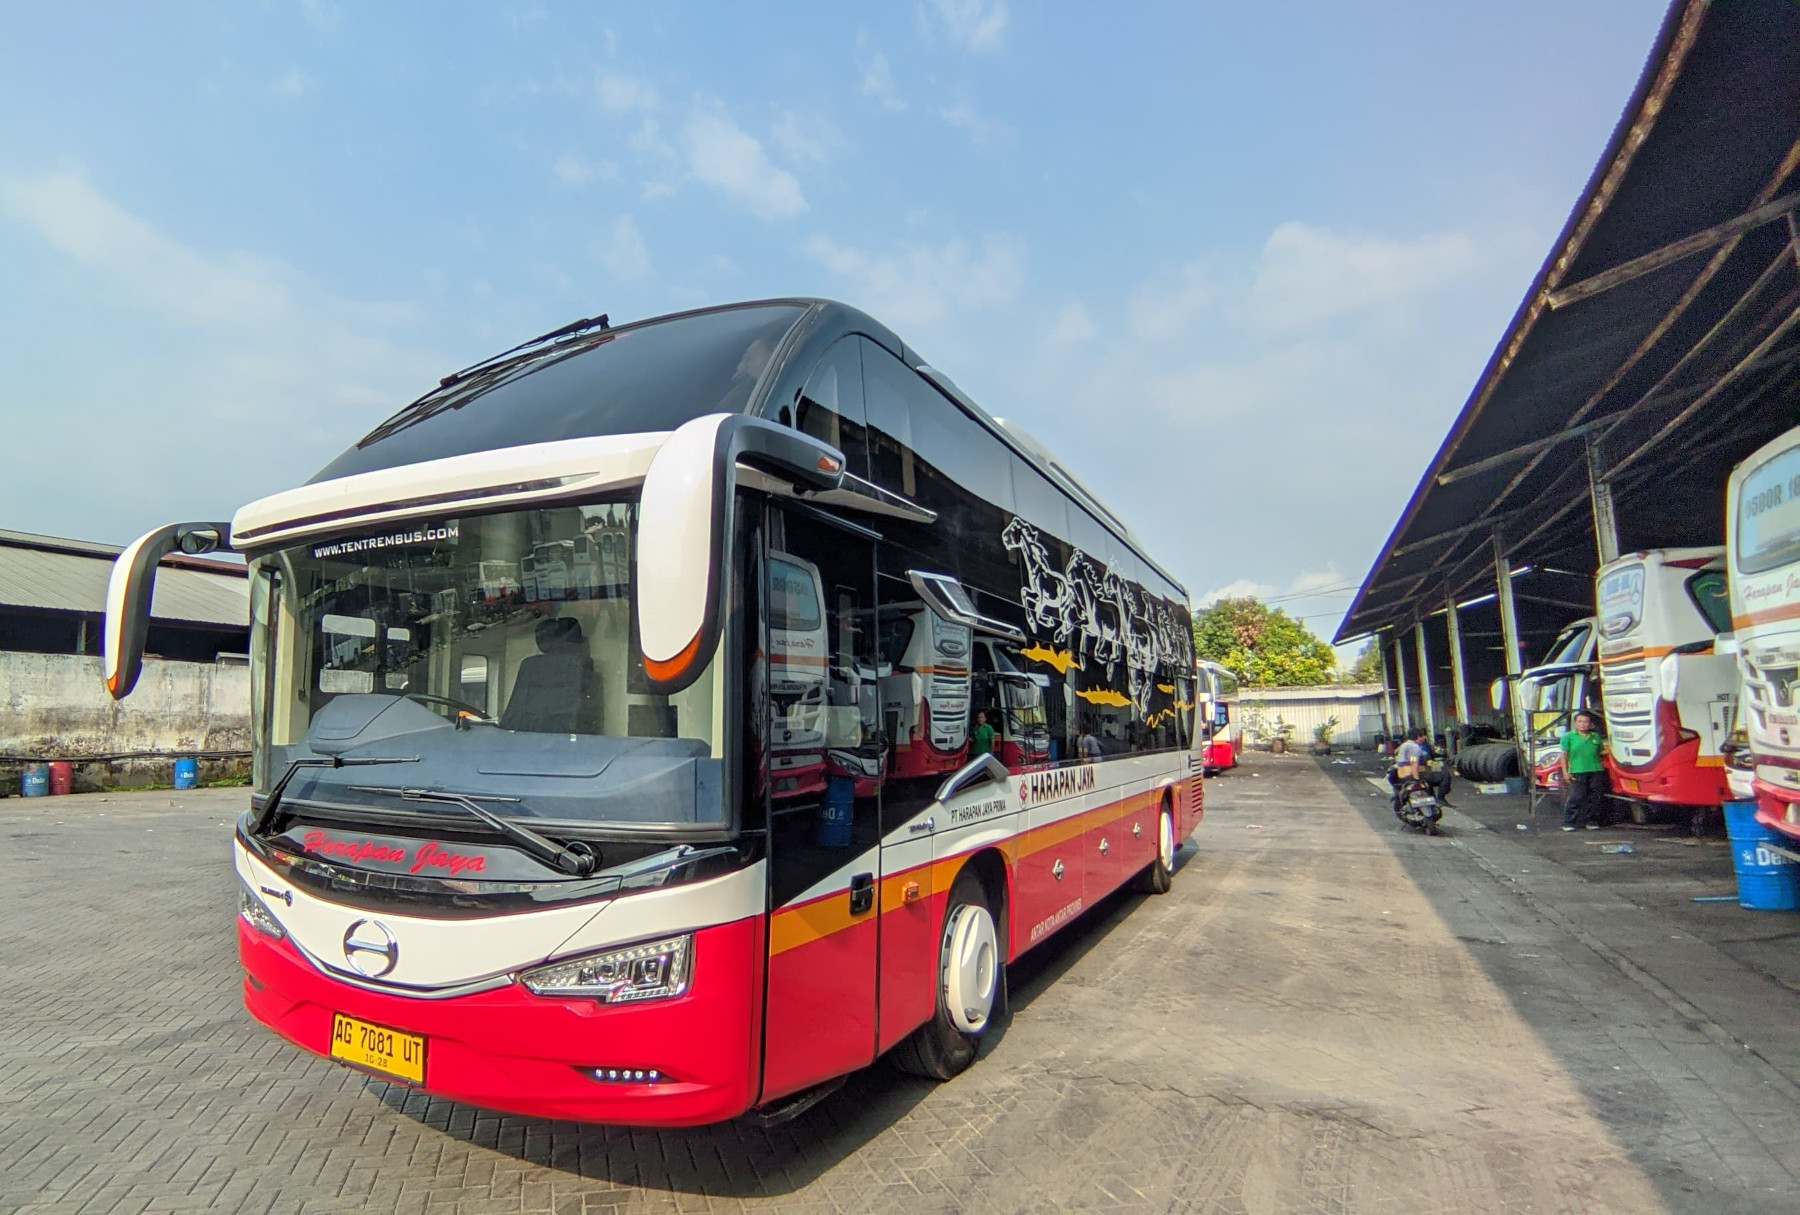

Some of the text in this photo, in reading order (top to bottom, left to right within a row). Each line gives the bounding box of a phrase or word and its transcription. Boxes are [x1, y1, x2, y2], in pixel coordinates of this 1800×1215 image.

[314, 526, 459, 558] WWW.TENTREMBUS.COM
[1031, 765, 1095, 804] HARAPAN JAYA
[951, 808, 958, 824] PT
[959, 804, 981, 822] HARAPAN
[982, 801, 993, 818] JAYA
[303, 830, 487, 876] Harapan Jaya
[335, 1019, 422, 1065] AG 7081 UT
